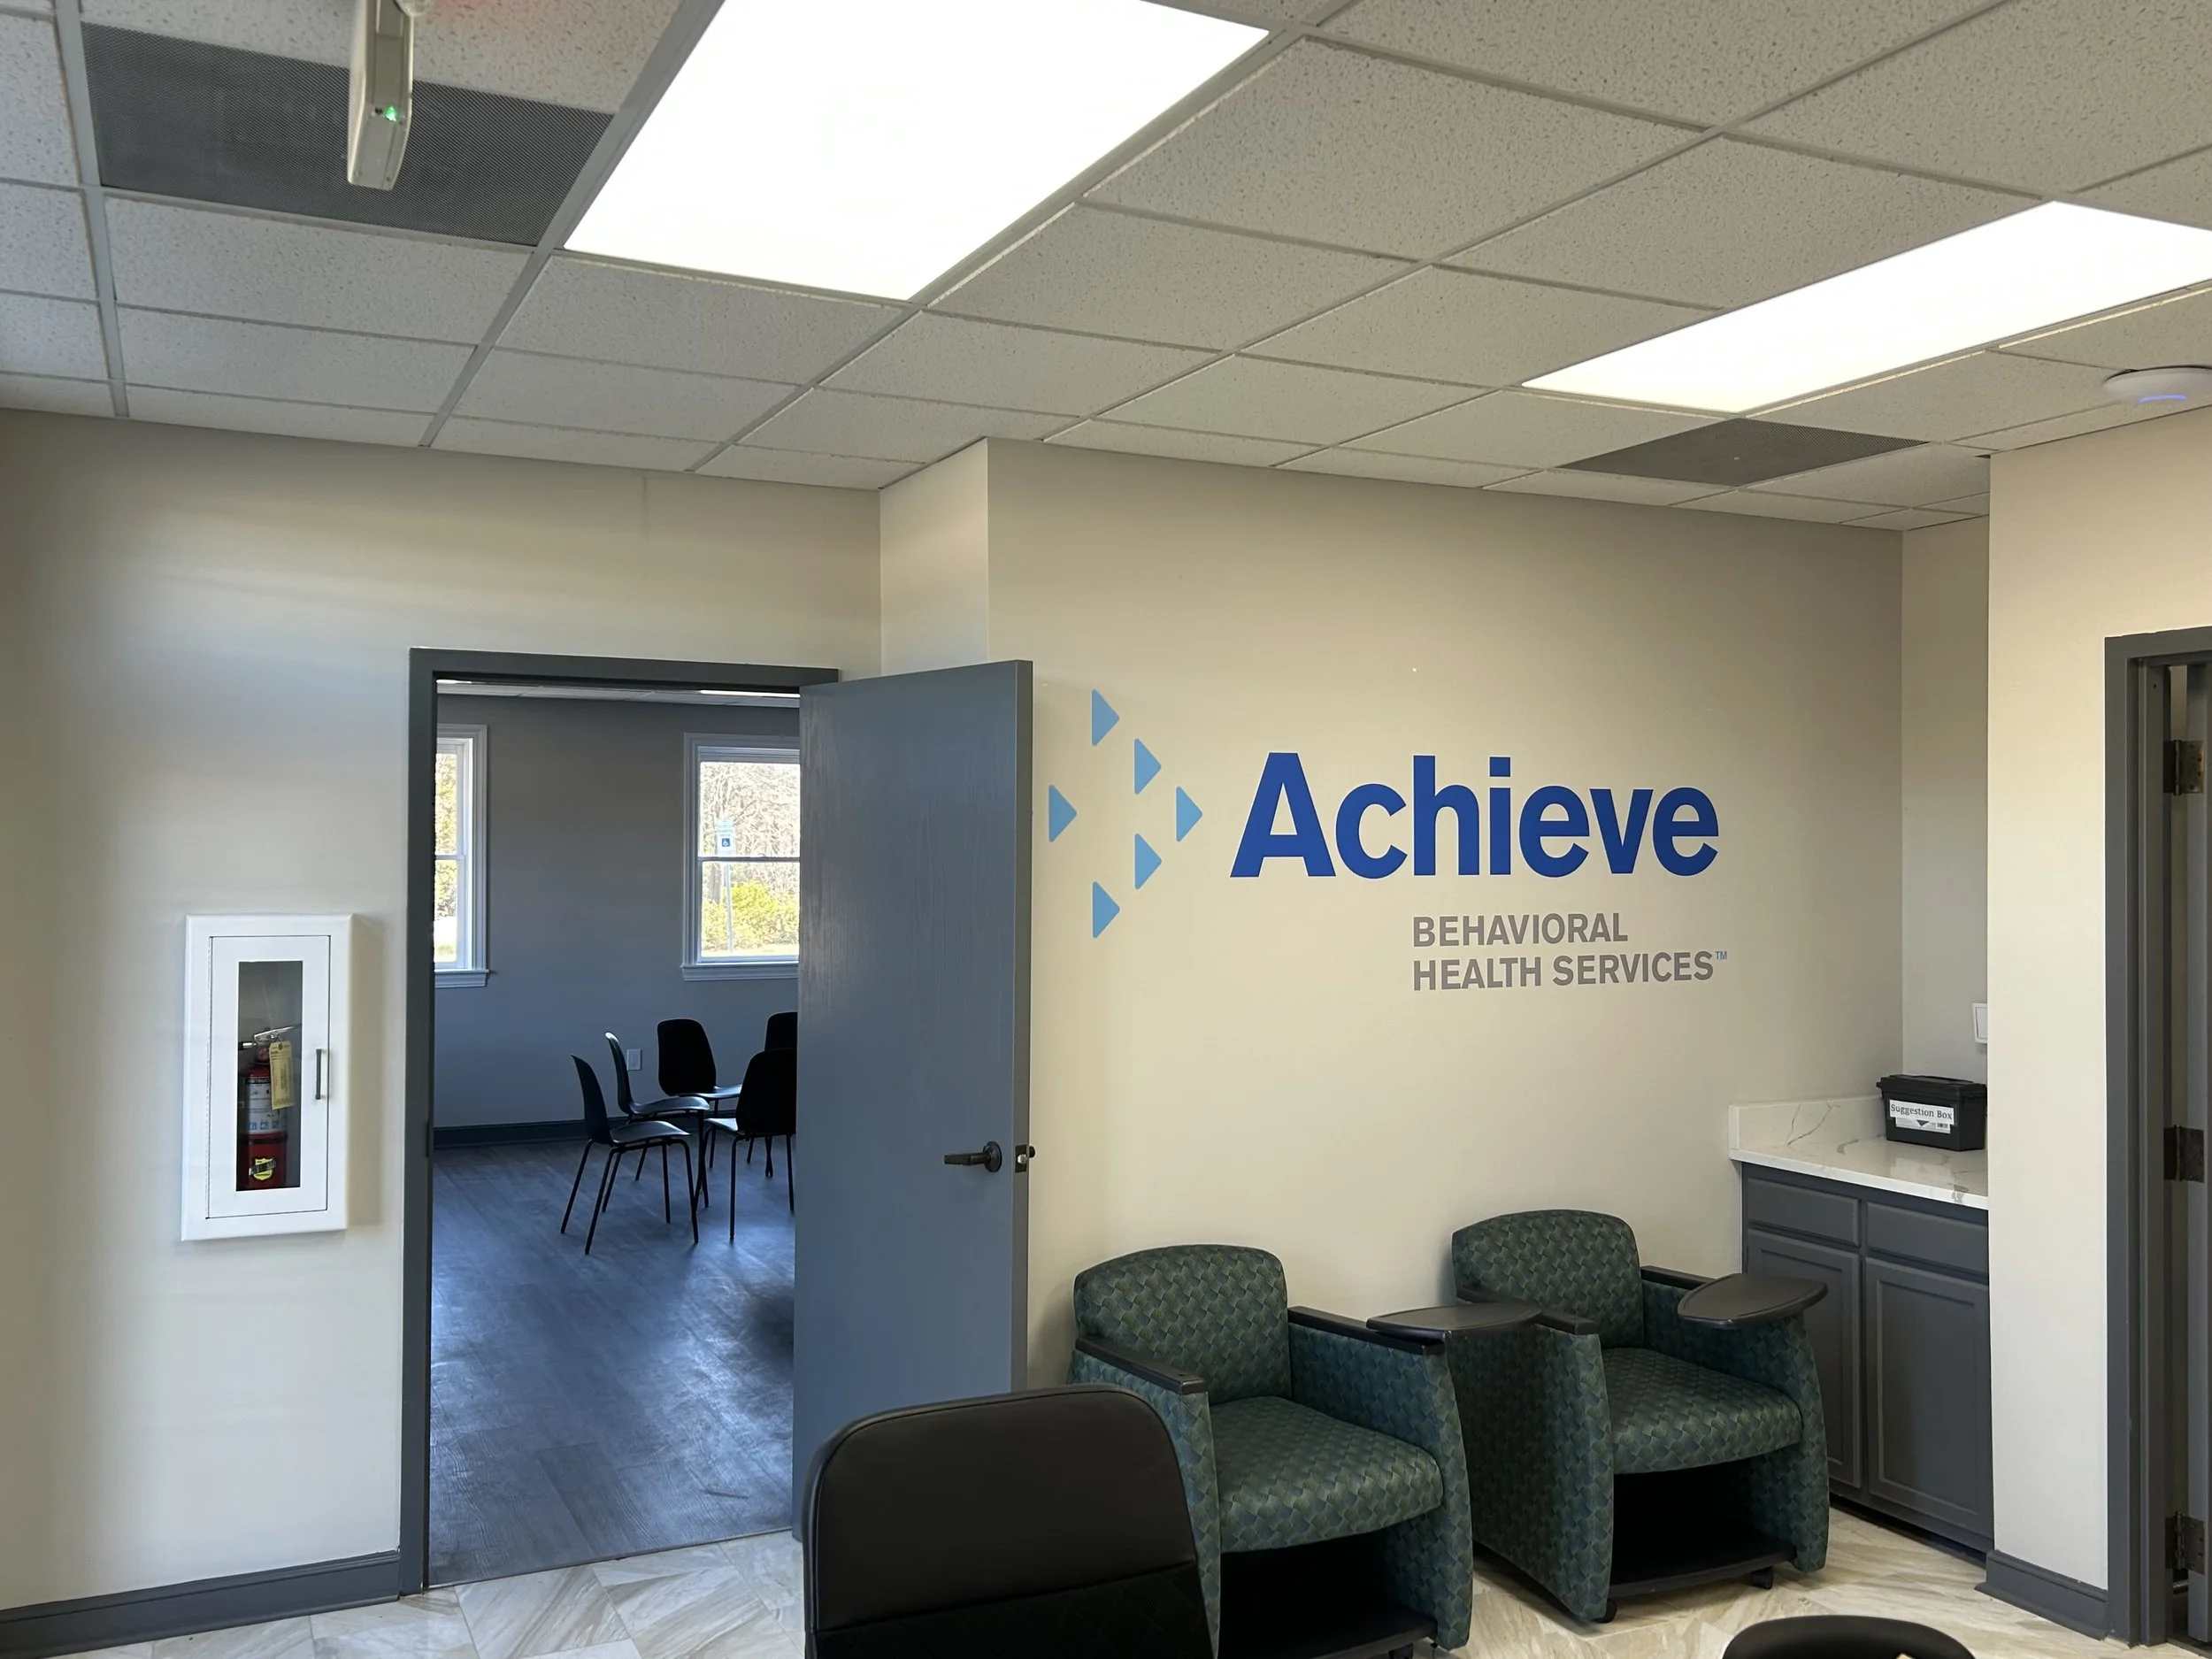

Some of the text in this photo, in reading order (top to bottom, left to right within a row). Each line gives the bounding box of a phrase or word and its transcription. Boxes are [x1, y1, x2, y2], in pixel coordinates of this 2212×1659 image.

[1230, 752, 1719, 879] Achieve
[1414, 913, 1628, 948] BEHAVIORAL
[1414, 956, 1542, 990] HEALTH
[1553, 950, 1713, 986] SERVICES
[1891, 1104, 1953, 1119] Suggestion Box
